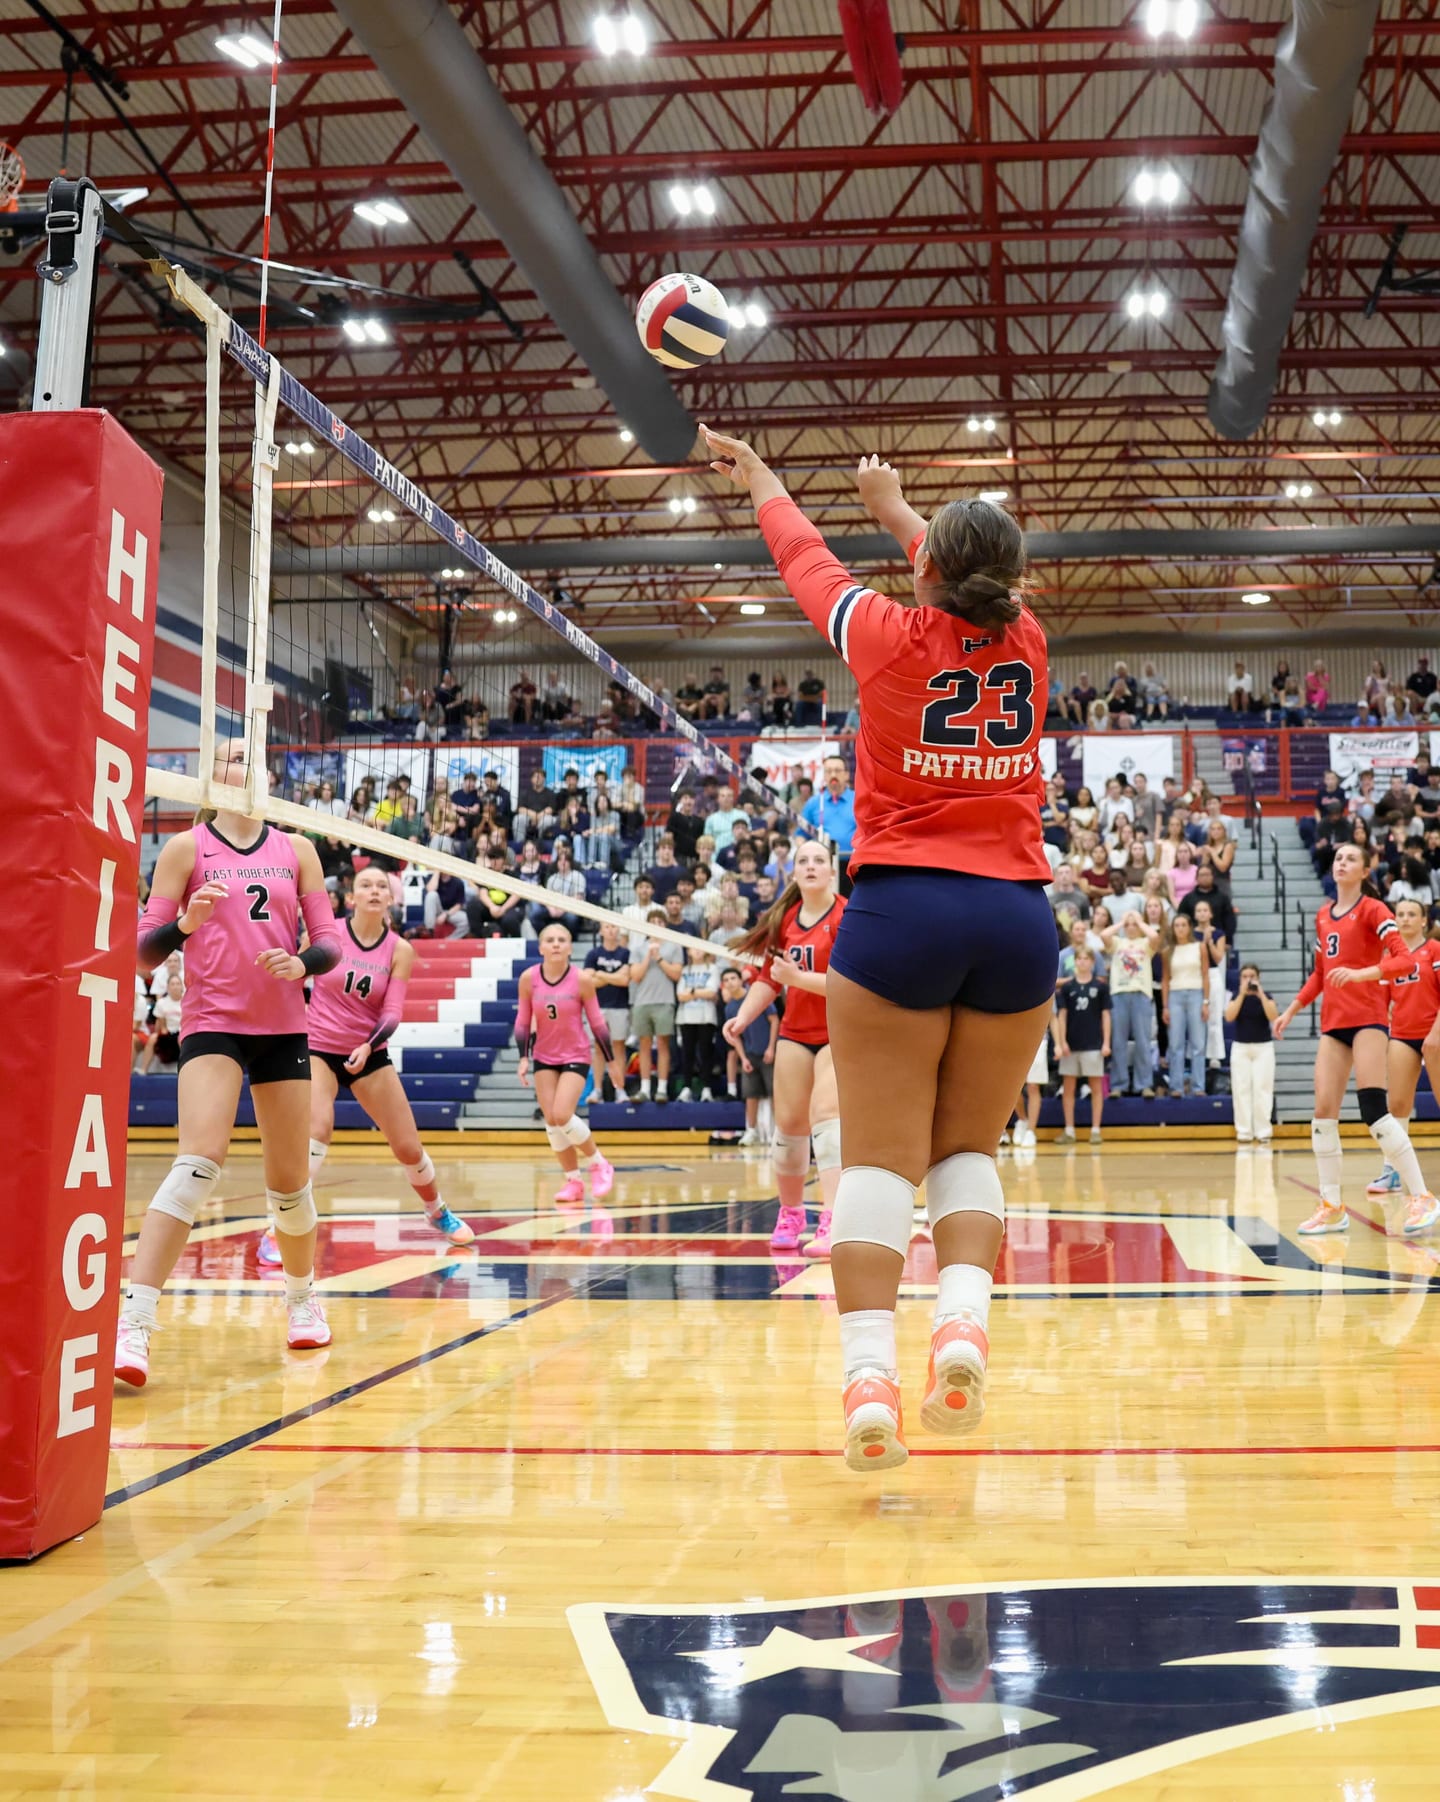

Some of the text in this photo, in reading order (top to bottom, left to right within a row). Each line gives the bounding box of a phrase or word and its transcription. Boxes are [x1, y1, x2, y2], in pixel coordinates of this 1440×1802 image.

[373, 450, 434, 523] PATRIOTS
[485, 550, 529, 603] PATRIOTS
[920, 660, 1035, 749] 23
[902, 747, 1037, 781] PATRIOTS
[204, 867, 295, 881] EAST ROBERTSON
[244, 883, 272, 922] 2
[788, 944, 815, 973] 21
[1326, 932, 1340, 959] 3
[56, 508, 148, 1439] HERITAGE
[342, 968, 373, 1000] 14
[545, 1002, 559, 1020] 3
